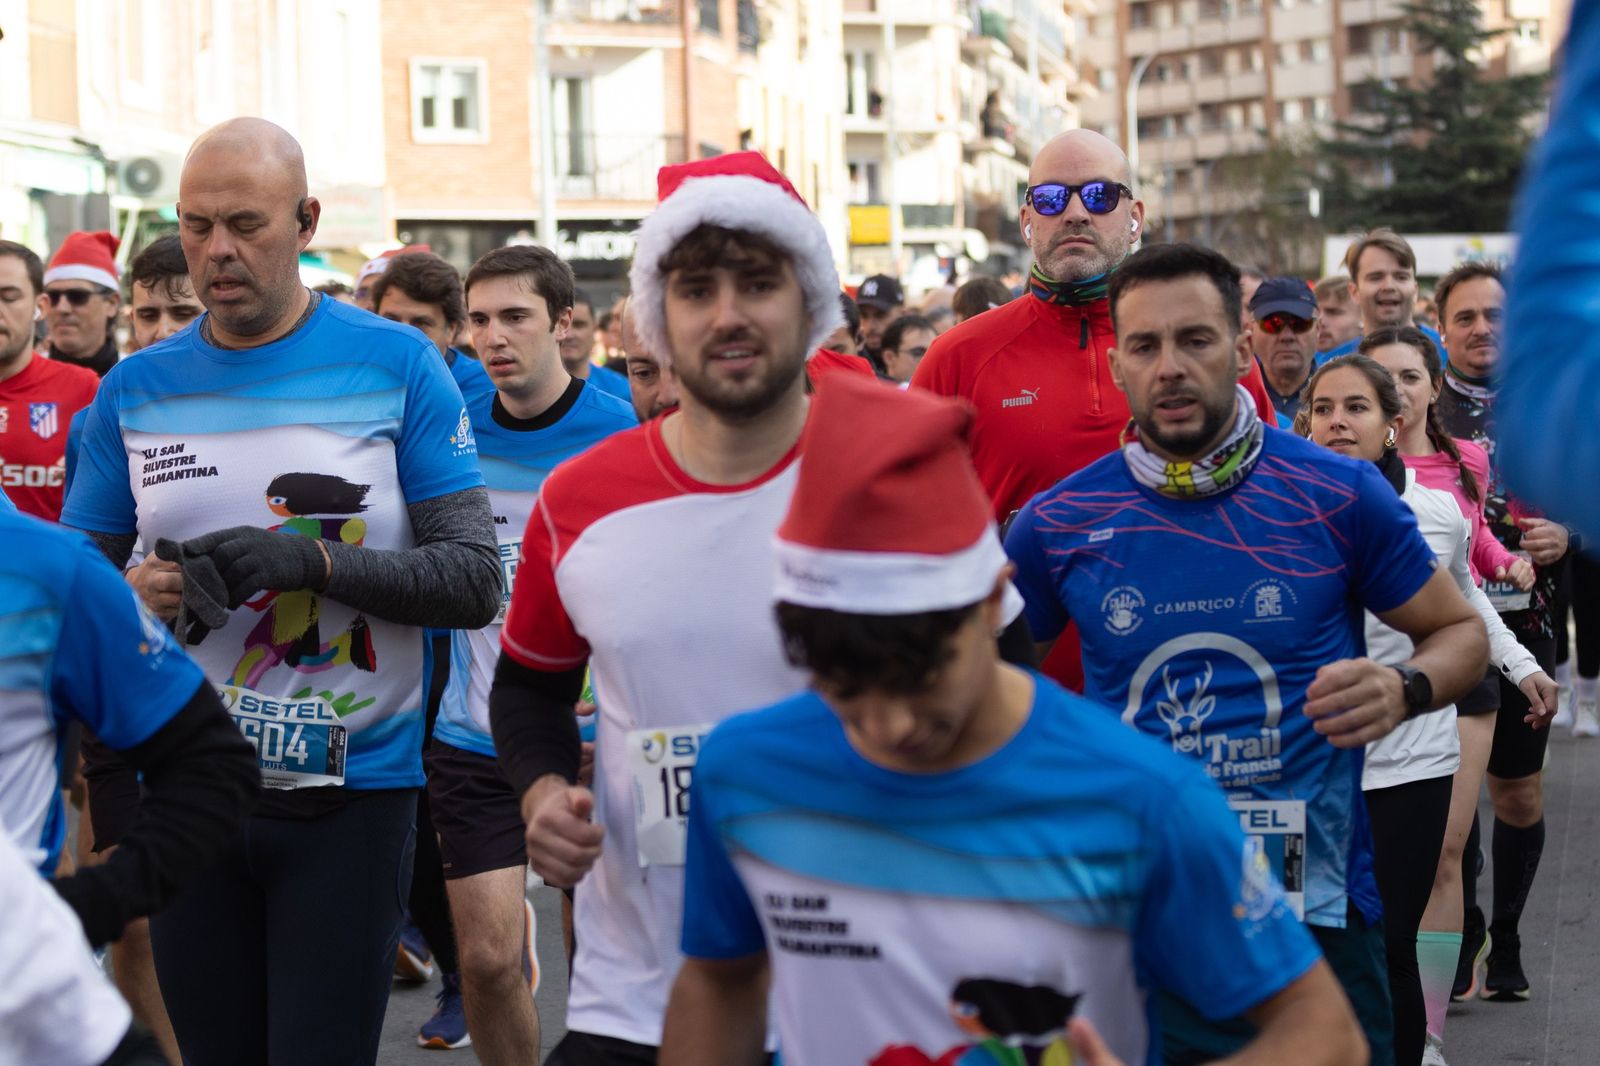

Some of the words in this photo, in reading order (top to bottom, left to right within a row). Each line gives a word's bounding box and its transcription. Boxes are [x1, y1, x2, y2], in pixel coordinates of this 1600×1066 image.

[1002, 396, 1033, 408] PUMA
[142, 448, 158, 460] XLI
[160, 443, 185, 456] SAN
[142, 454, 197, 474] SILVESTRE
[142, 466, 219, 488] SALMANTINA
[1153, 597, 1236, 616] CAMBRICO
[239, 695, 333, 720] SETEL
[229, 715, 309, 766] 604
[1204, 727, 1282, 764] Trail
[262, 760, 288, 772] LUIS
[1223, 756, 1283, 776] Francia
